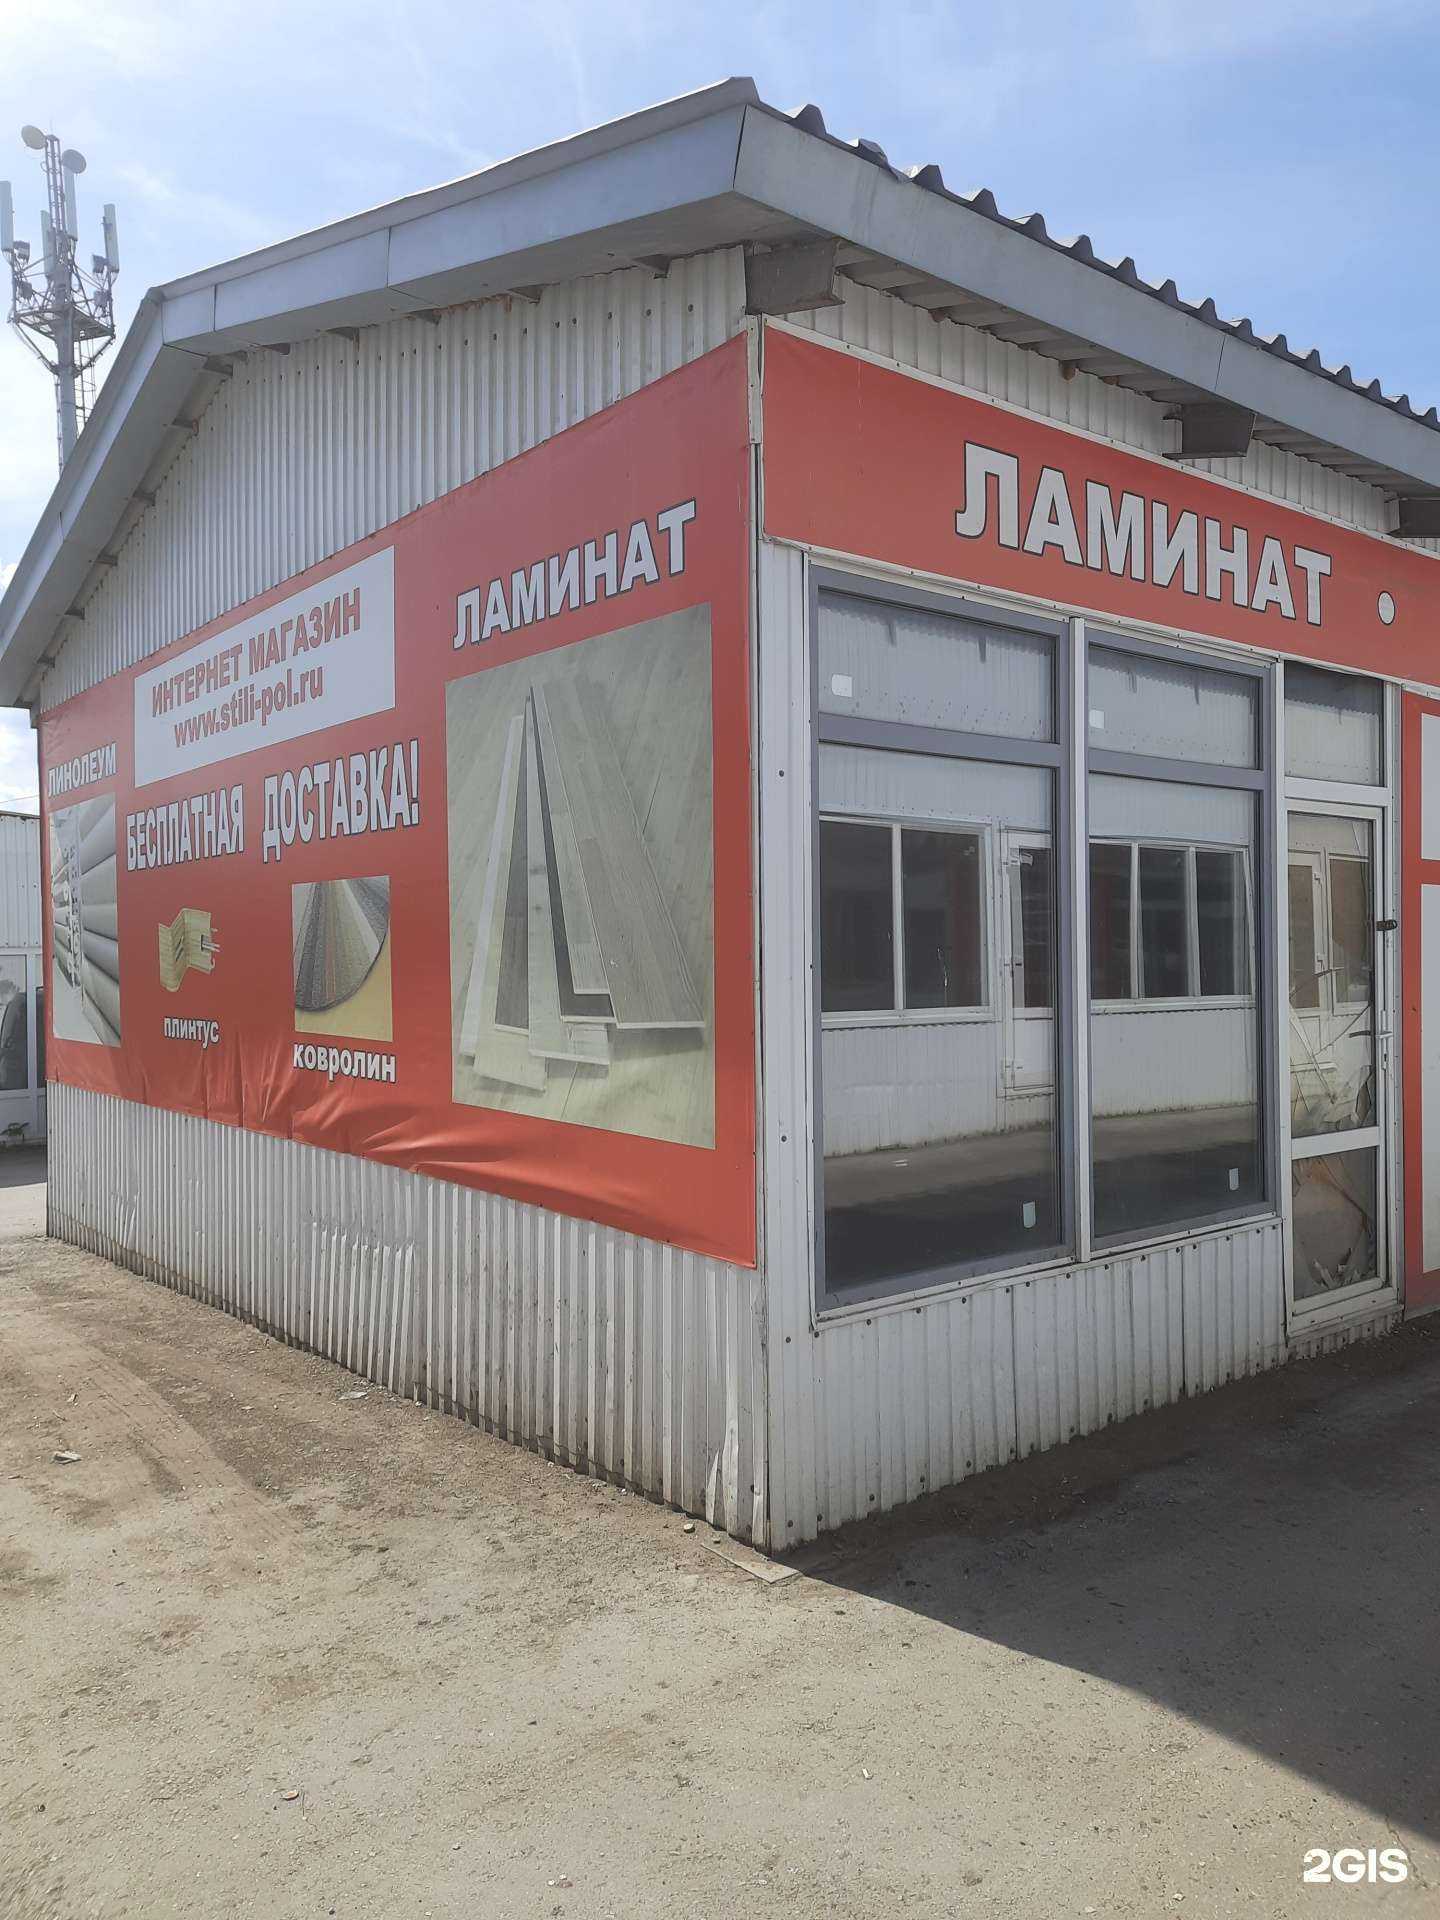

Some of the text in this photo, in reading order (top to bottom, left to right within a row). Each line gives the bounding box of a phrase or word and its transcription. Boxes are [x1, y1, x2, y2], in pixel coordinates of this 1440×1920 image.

[453, 498, 696, 650] ЛАМИНАТ
[955, 440, 1332, 627] ЛАМИНАТ
[152, 587, 361, 718] ИНТЕРНЕТ МАГАЗИН
[174, 666, 324, 748] www.stili-pol.ru
[48, 741, 117, 798] ЛИНОЛЕУМ
[126, 738, 419, 872] БЕСПЛАТНАЯ ДОСТАВКА!
[163, 1016, 220, 1048] плинтус
[293, 1042, 397, 1083] ковролин
